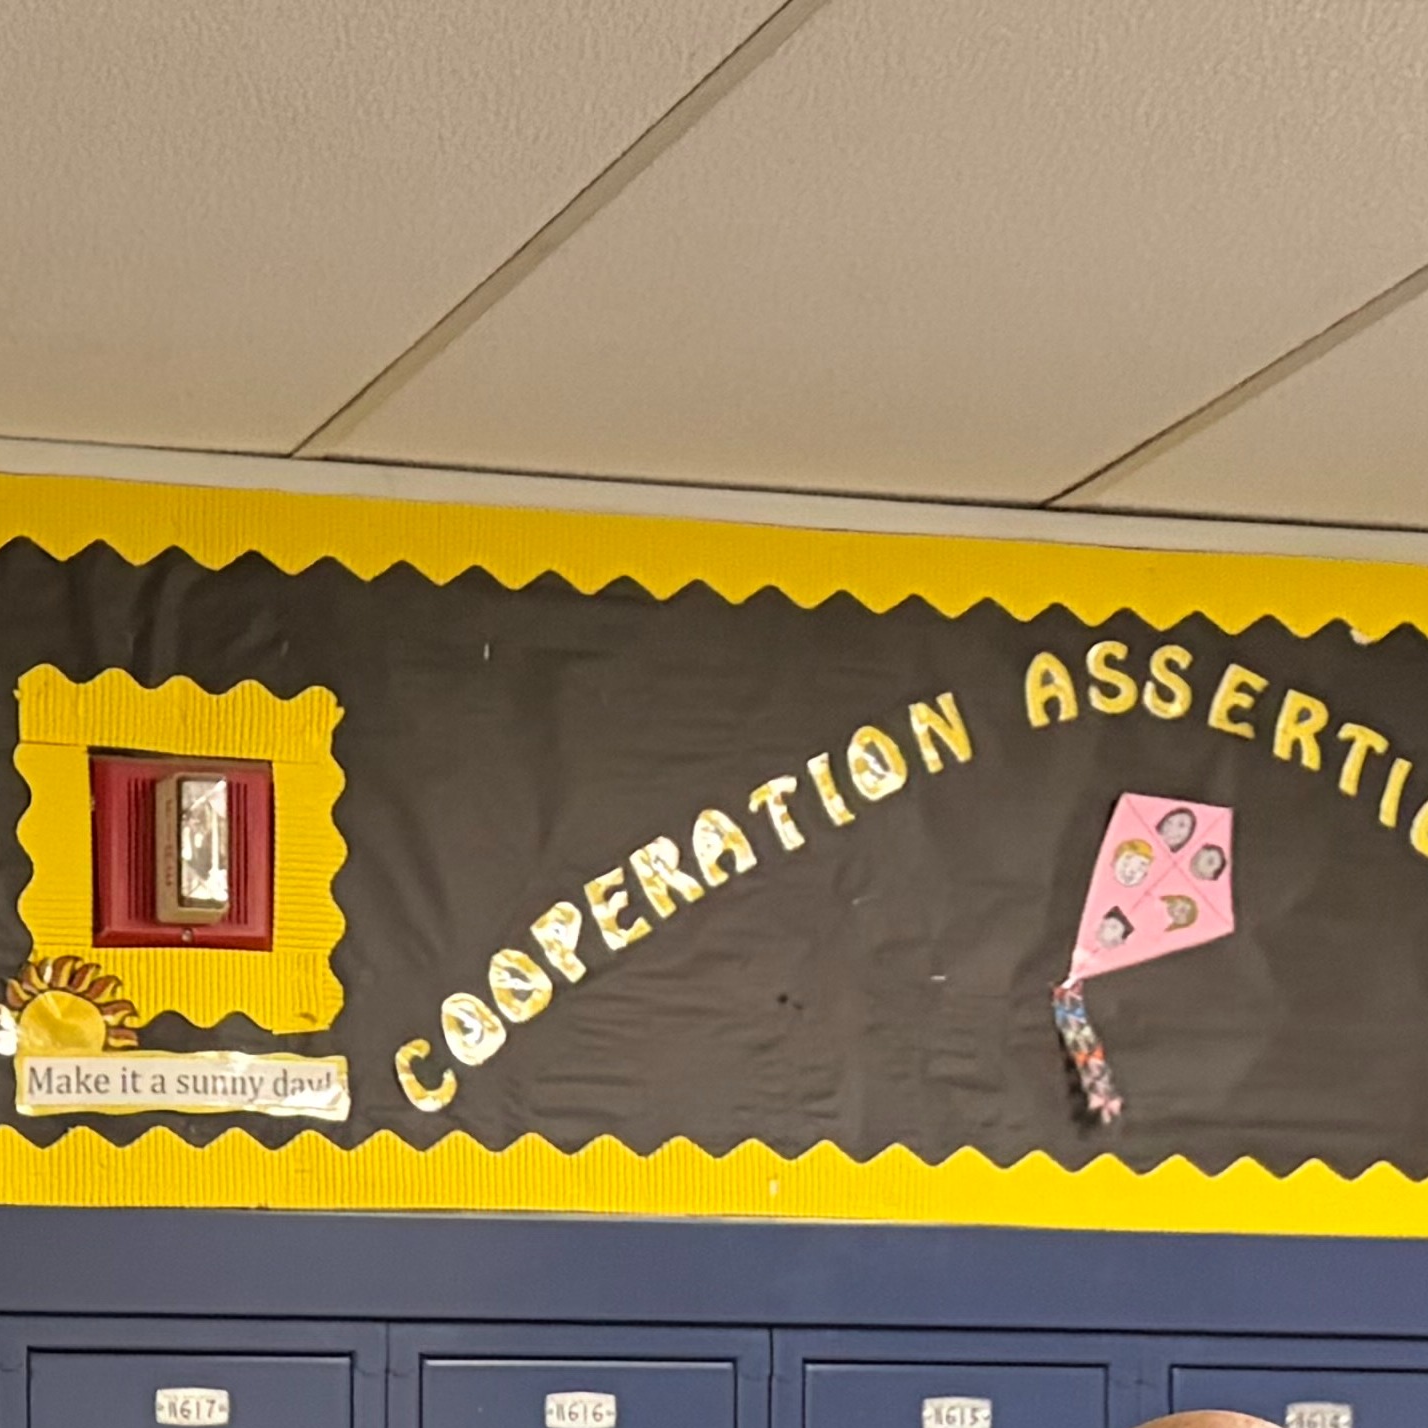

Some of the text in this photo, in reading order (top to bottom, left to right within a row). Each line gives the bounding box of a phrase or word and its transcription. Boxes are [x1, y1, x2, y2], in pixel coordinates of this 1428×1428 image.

[395, 692, 972, 1113] COOPERATION
[28, 1065, 110, 1095] Make
[120, 1066, 142, 1095] it
[151, 1074, 167, 1095] a
[176, 1072, 264, 1100] sunny
